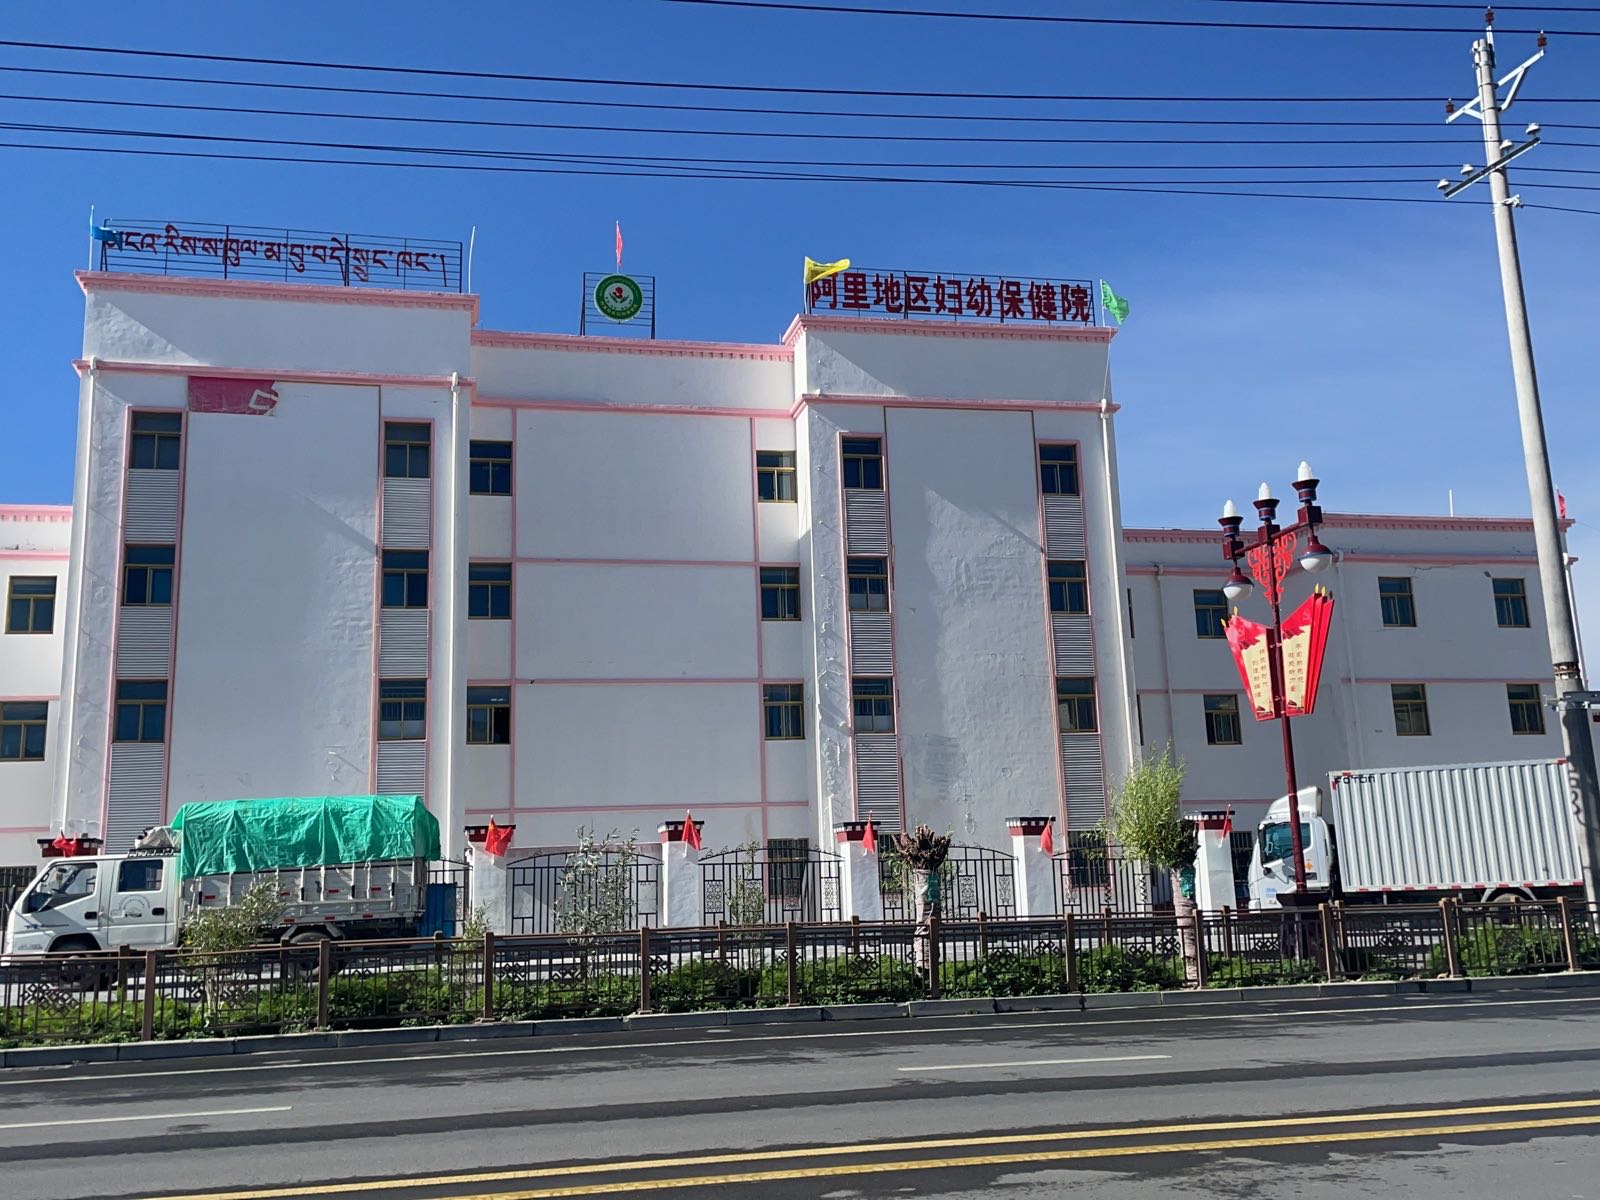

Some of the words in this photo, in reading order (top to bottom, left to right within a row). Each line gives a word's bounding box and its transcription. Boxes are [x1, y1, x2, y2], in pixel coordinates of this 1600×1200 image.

[811, 272, 1090, 321] 阿里地区妇幼保健院
